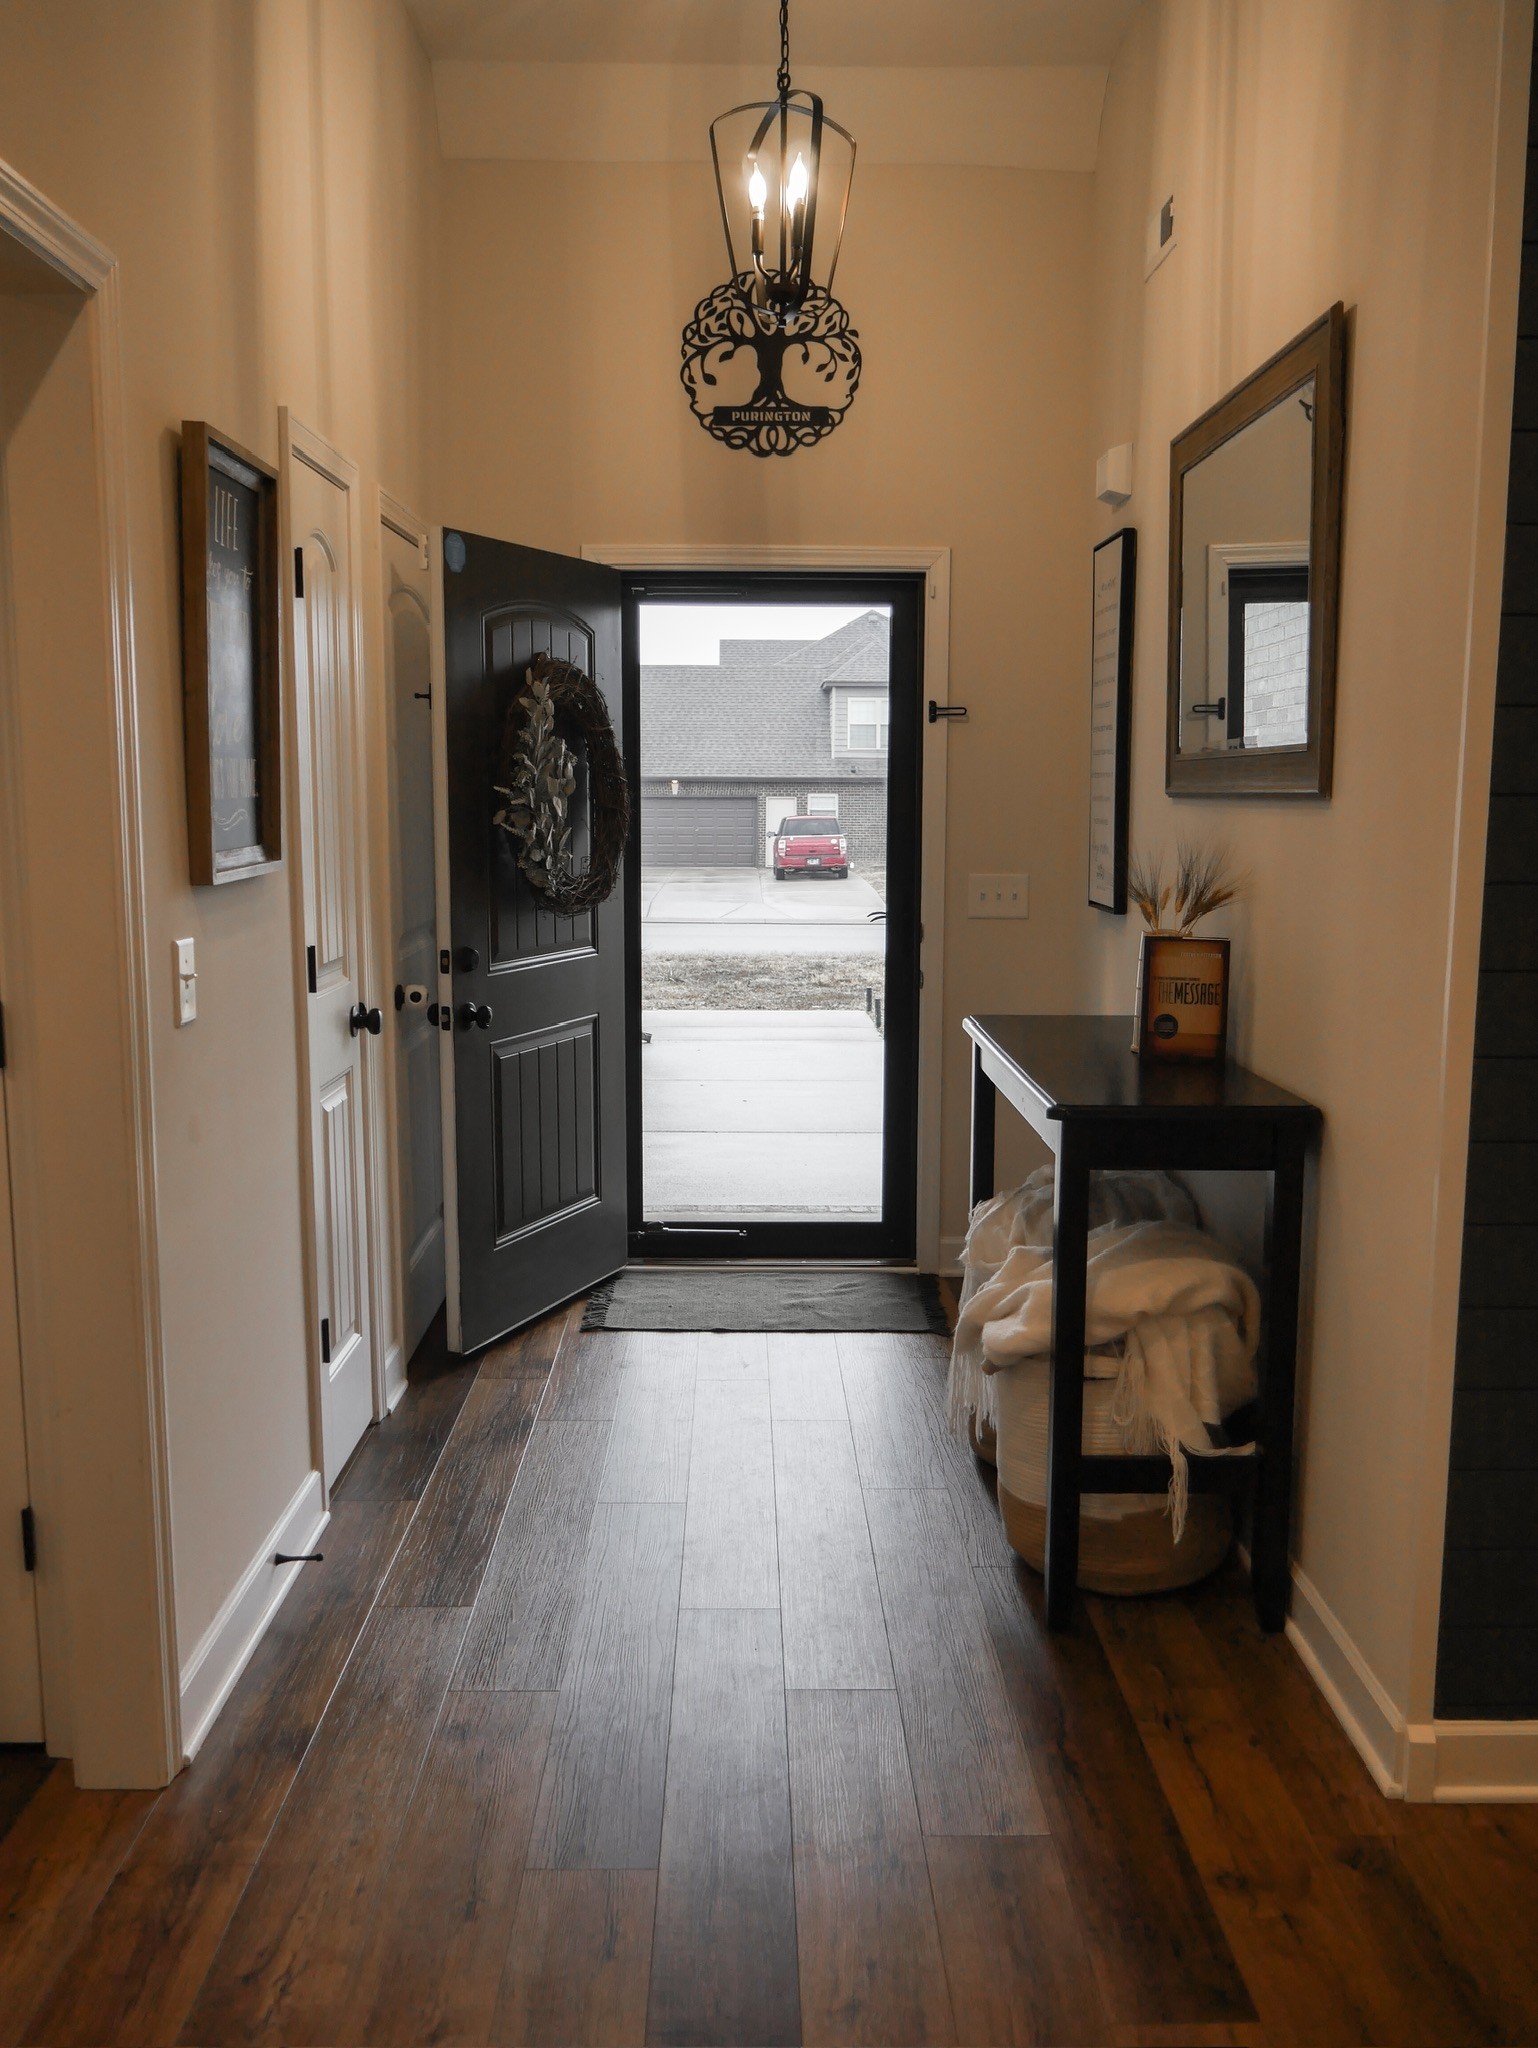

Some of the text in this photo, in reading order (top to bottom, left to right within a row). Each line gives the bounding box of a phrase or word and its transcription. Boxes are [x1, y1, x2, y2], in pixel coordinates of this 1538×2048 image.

[732, 411, 811, 421] PURINGTON
[214, 485, 239, 551] LIFE
[1174, 983, 1220, 1005] MESSAGE
